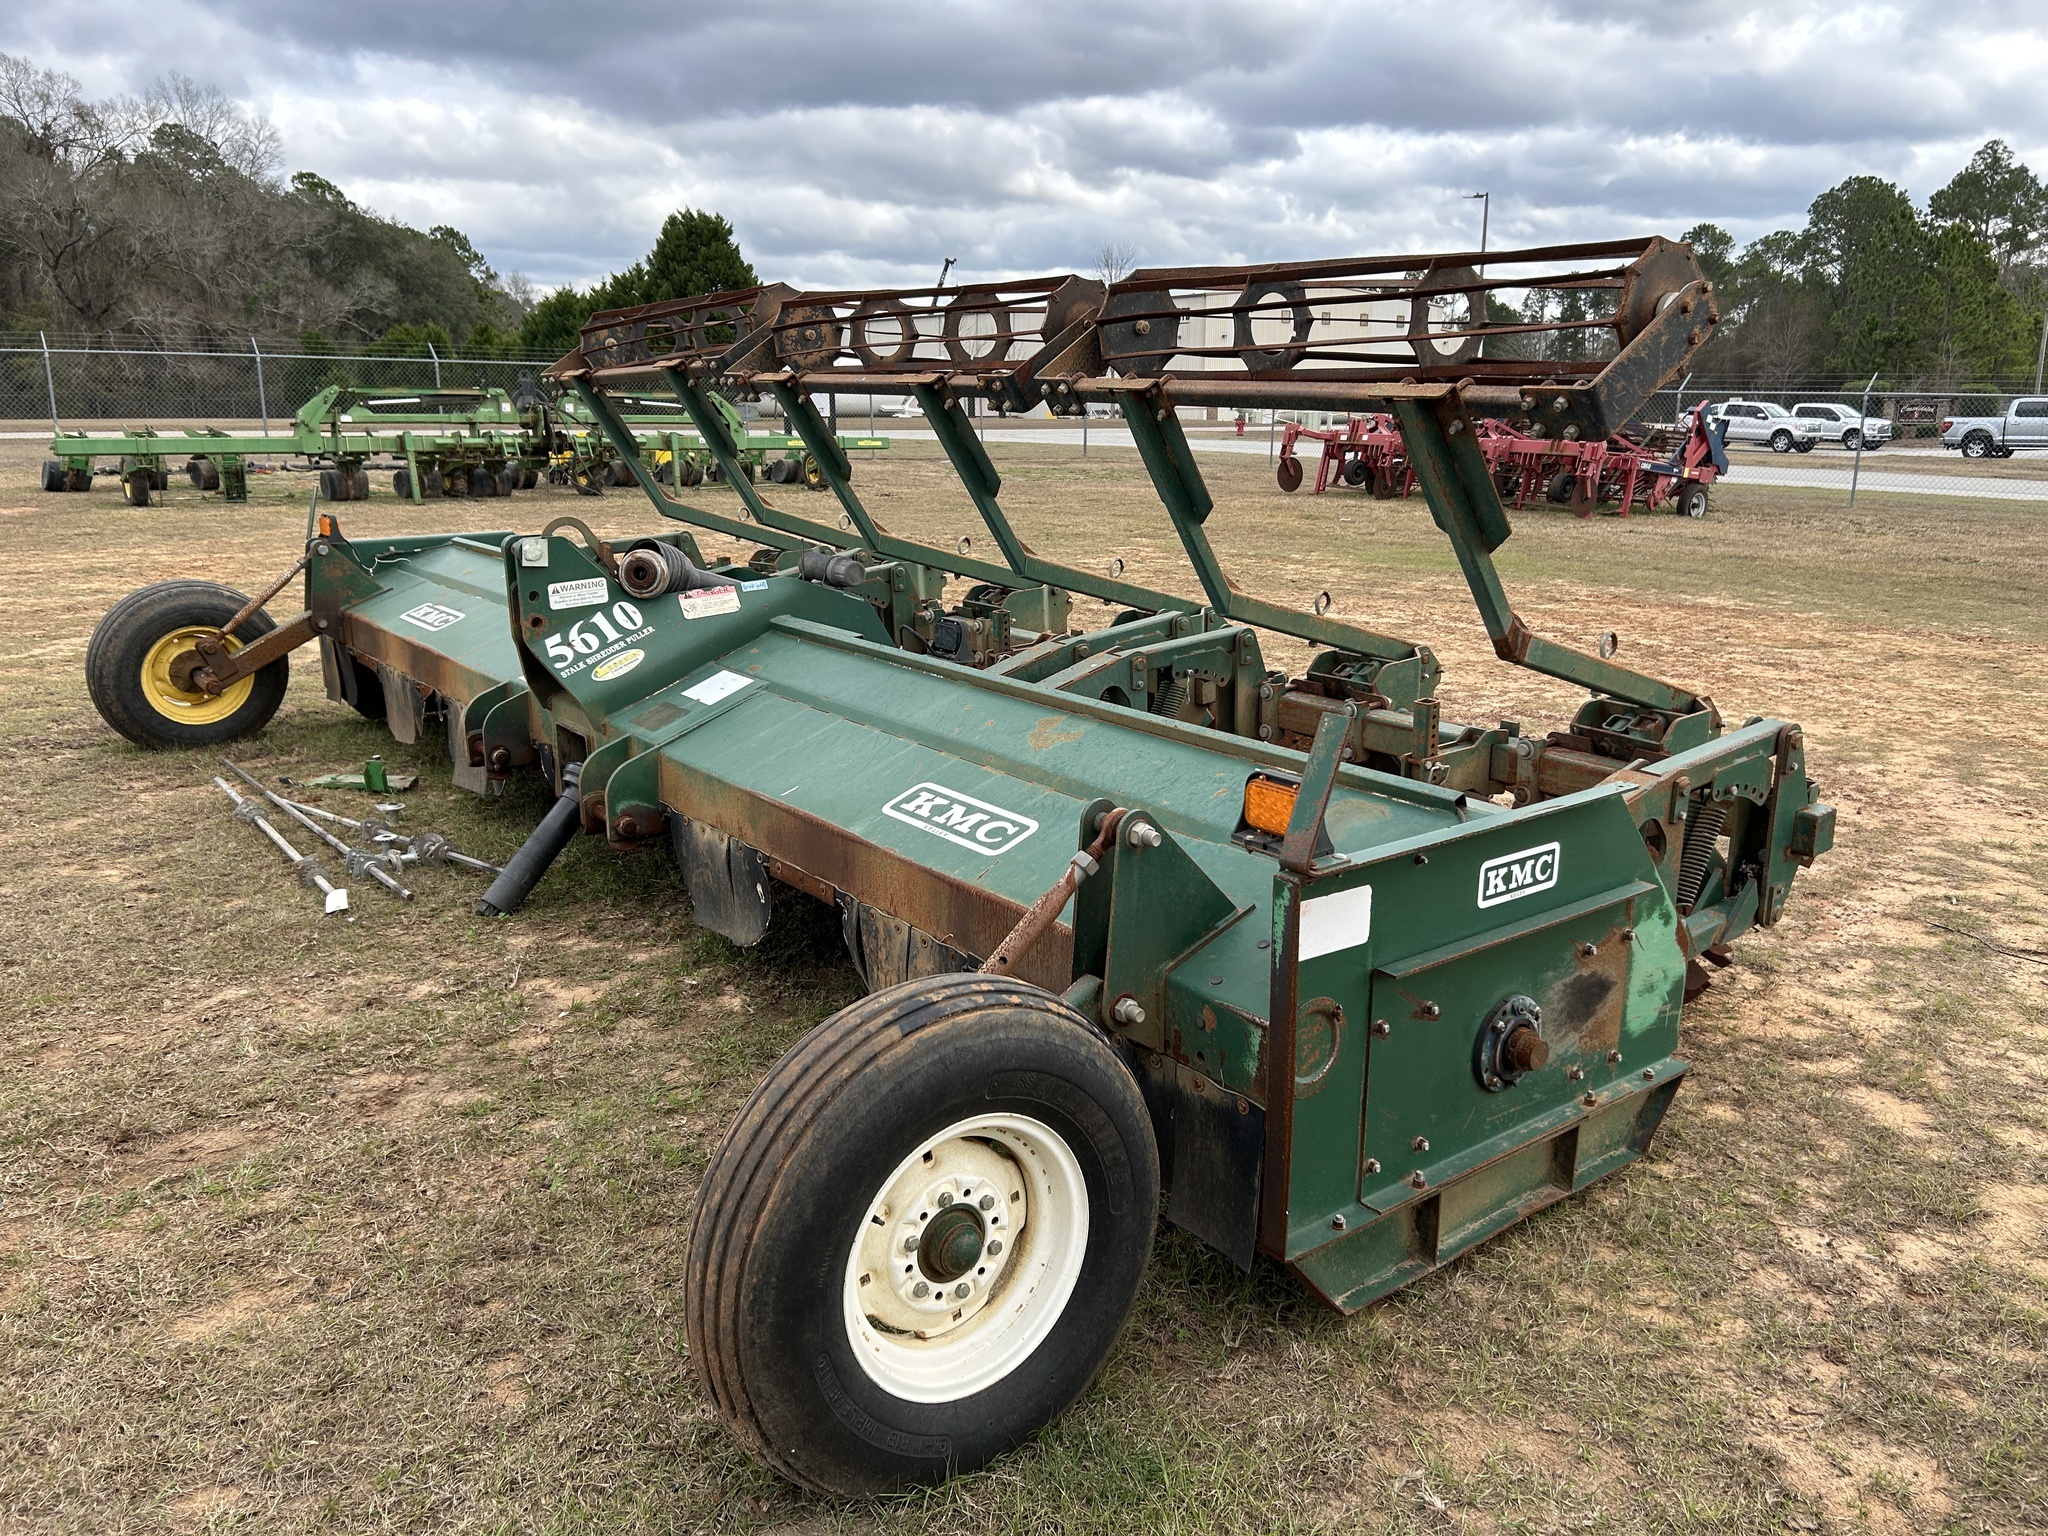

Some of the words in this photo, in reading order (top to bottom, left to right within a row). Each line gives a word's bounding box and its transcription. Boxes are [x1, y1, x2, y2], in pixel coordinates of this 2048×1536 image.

[560, 580, 605, 592] WARNING
[409, 605, 456, 627] KMC
[544, 601, 643, 669] 5610
[560, 662, 588, 679] STALK
[585, 642, 627, 666] SHREDDER
[625, 625, 656, 645] PULLER
[899, 791, 1020, 843] KMC
[922, 824, 950, 838] KELLEY
[1485, 853, 1553, 897] KMC
[819, 1367, 879, 1439] IMPLEMENT
